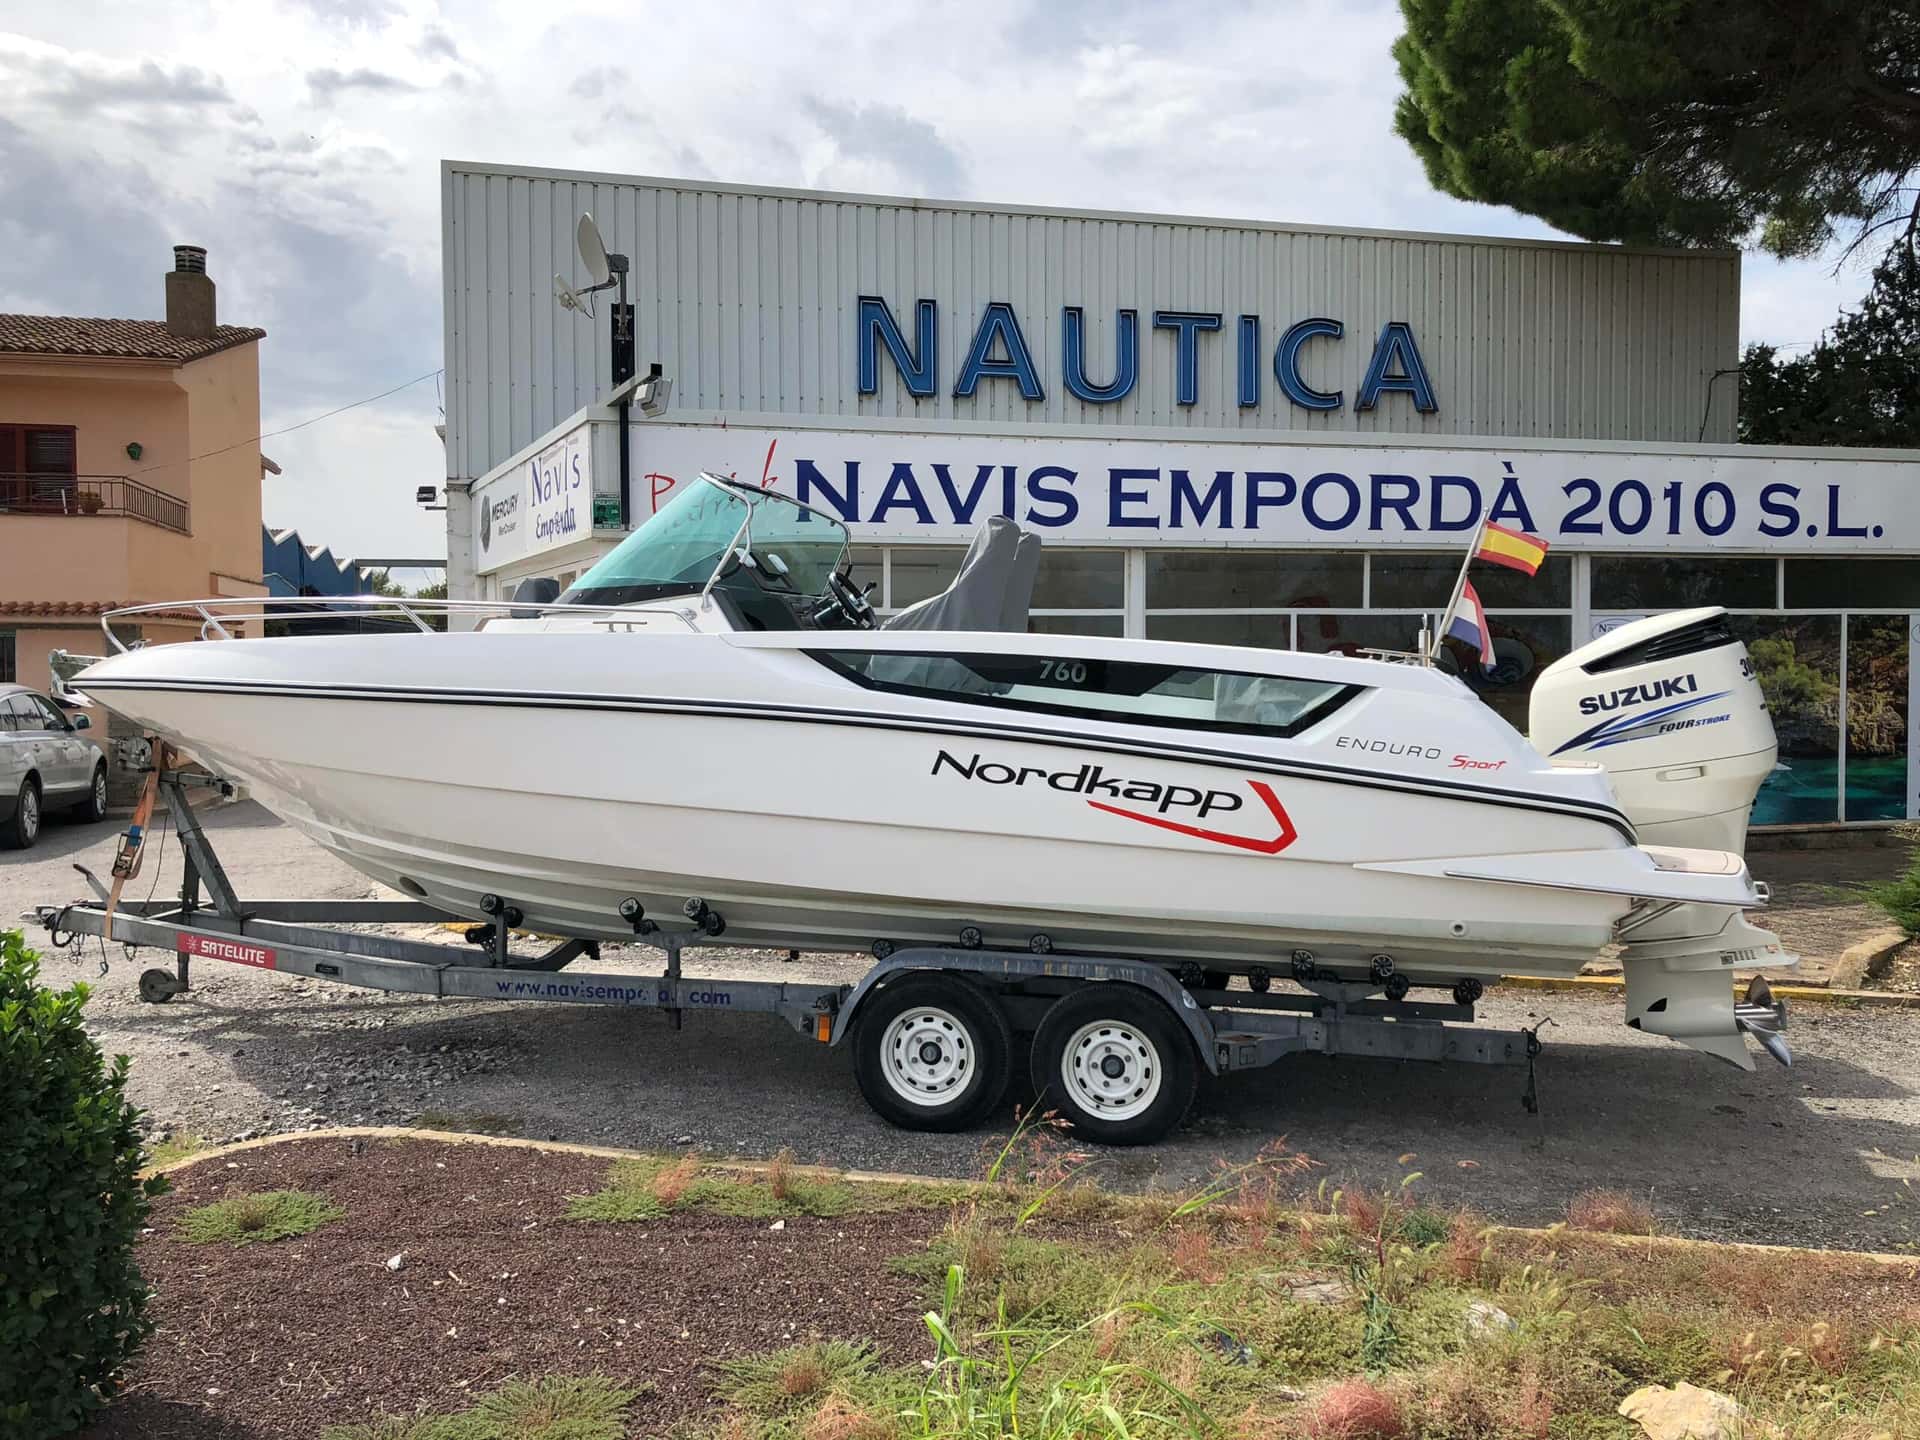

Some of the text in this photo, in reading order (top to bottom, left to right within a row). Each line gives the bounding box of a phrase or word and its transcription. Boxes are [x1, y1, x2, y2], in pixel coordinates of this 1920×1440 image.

[858, 296, 1439, 413] NAUTICA
[491, 493, 519, 522] MERCURY
[794, 459, 1883, 540] NAVIS EMPORDÀ 2010 S.L.
[1039, 659, 1087, 684] 760
[1579, 674, 1698, 715] SUZUKI
[1335, 736, 1508, 770] ENDURO Sport
[931, 750, 1243, 818] Nordkapp
[200, 940, 266, 964] SATELLITE
